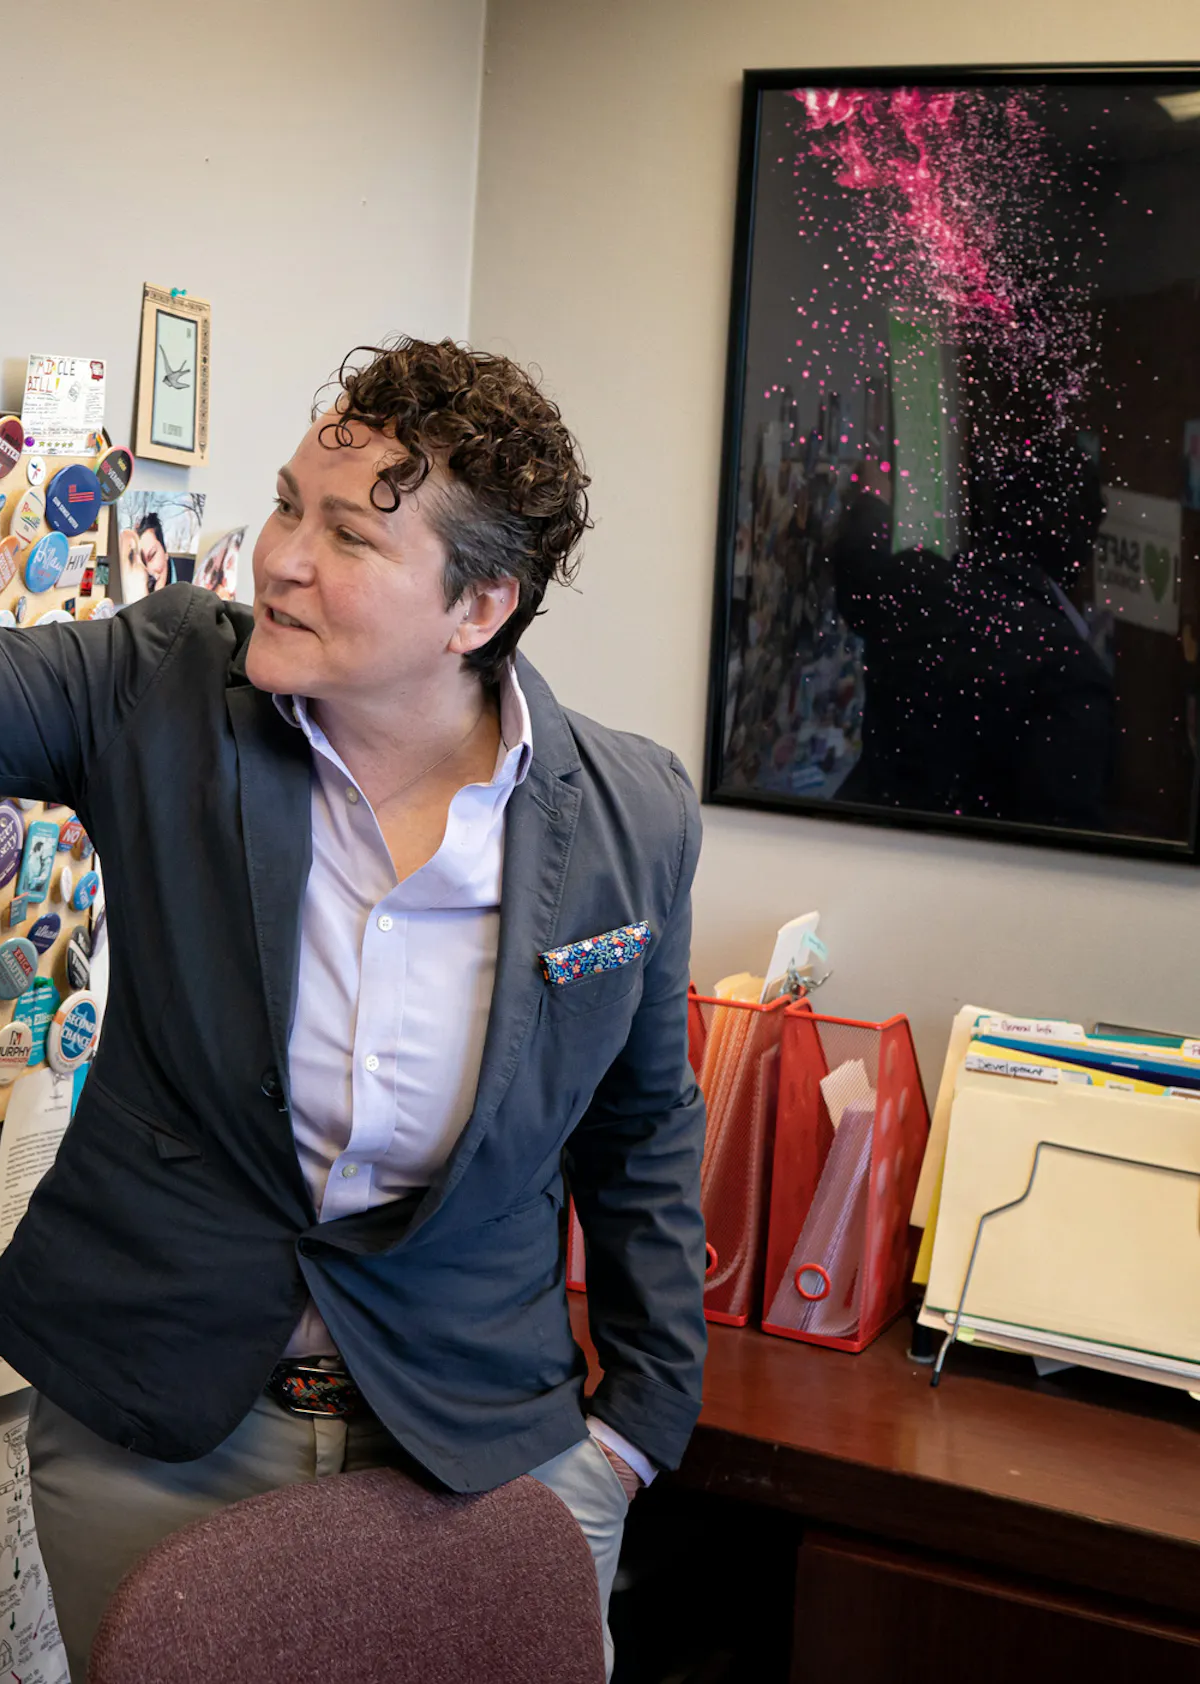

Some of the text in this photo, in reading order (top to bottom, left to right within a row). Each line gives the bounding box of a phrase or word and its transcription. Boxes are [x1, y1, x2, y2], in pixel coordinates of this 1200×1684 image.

[66, 553, 90, 572] HIV
[62, 829, 81, 844] NO
[1, 949, 30, 988] MAUTER
[13, 947, 32, 975] ERICA
[66, 1013, 97, 1031] SECOND
[61, 1028, 91, 1049] CHANCE
[977, 1058, 1044, 1077] Development
